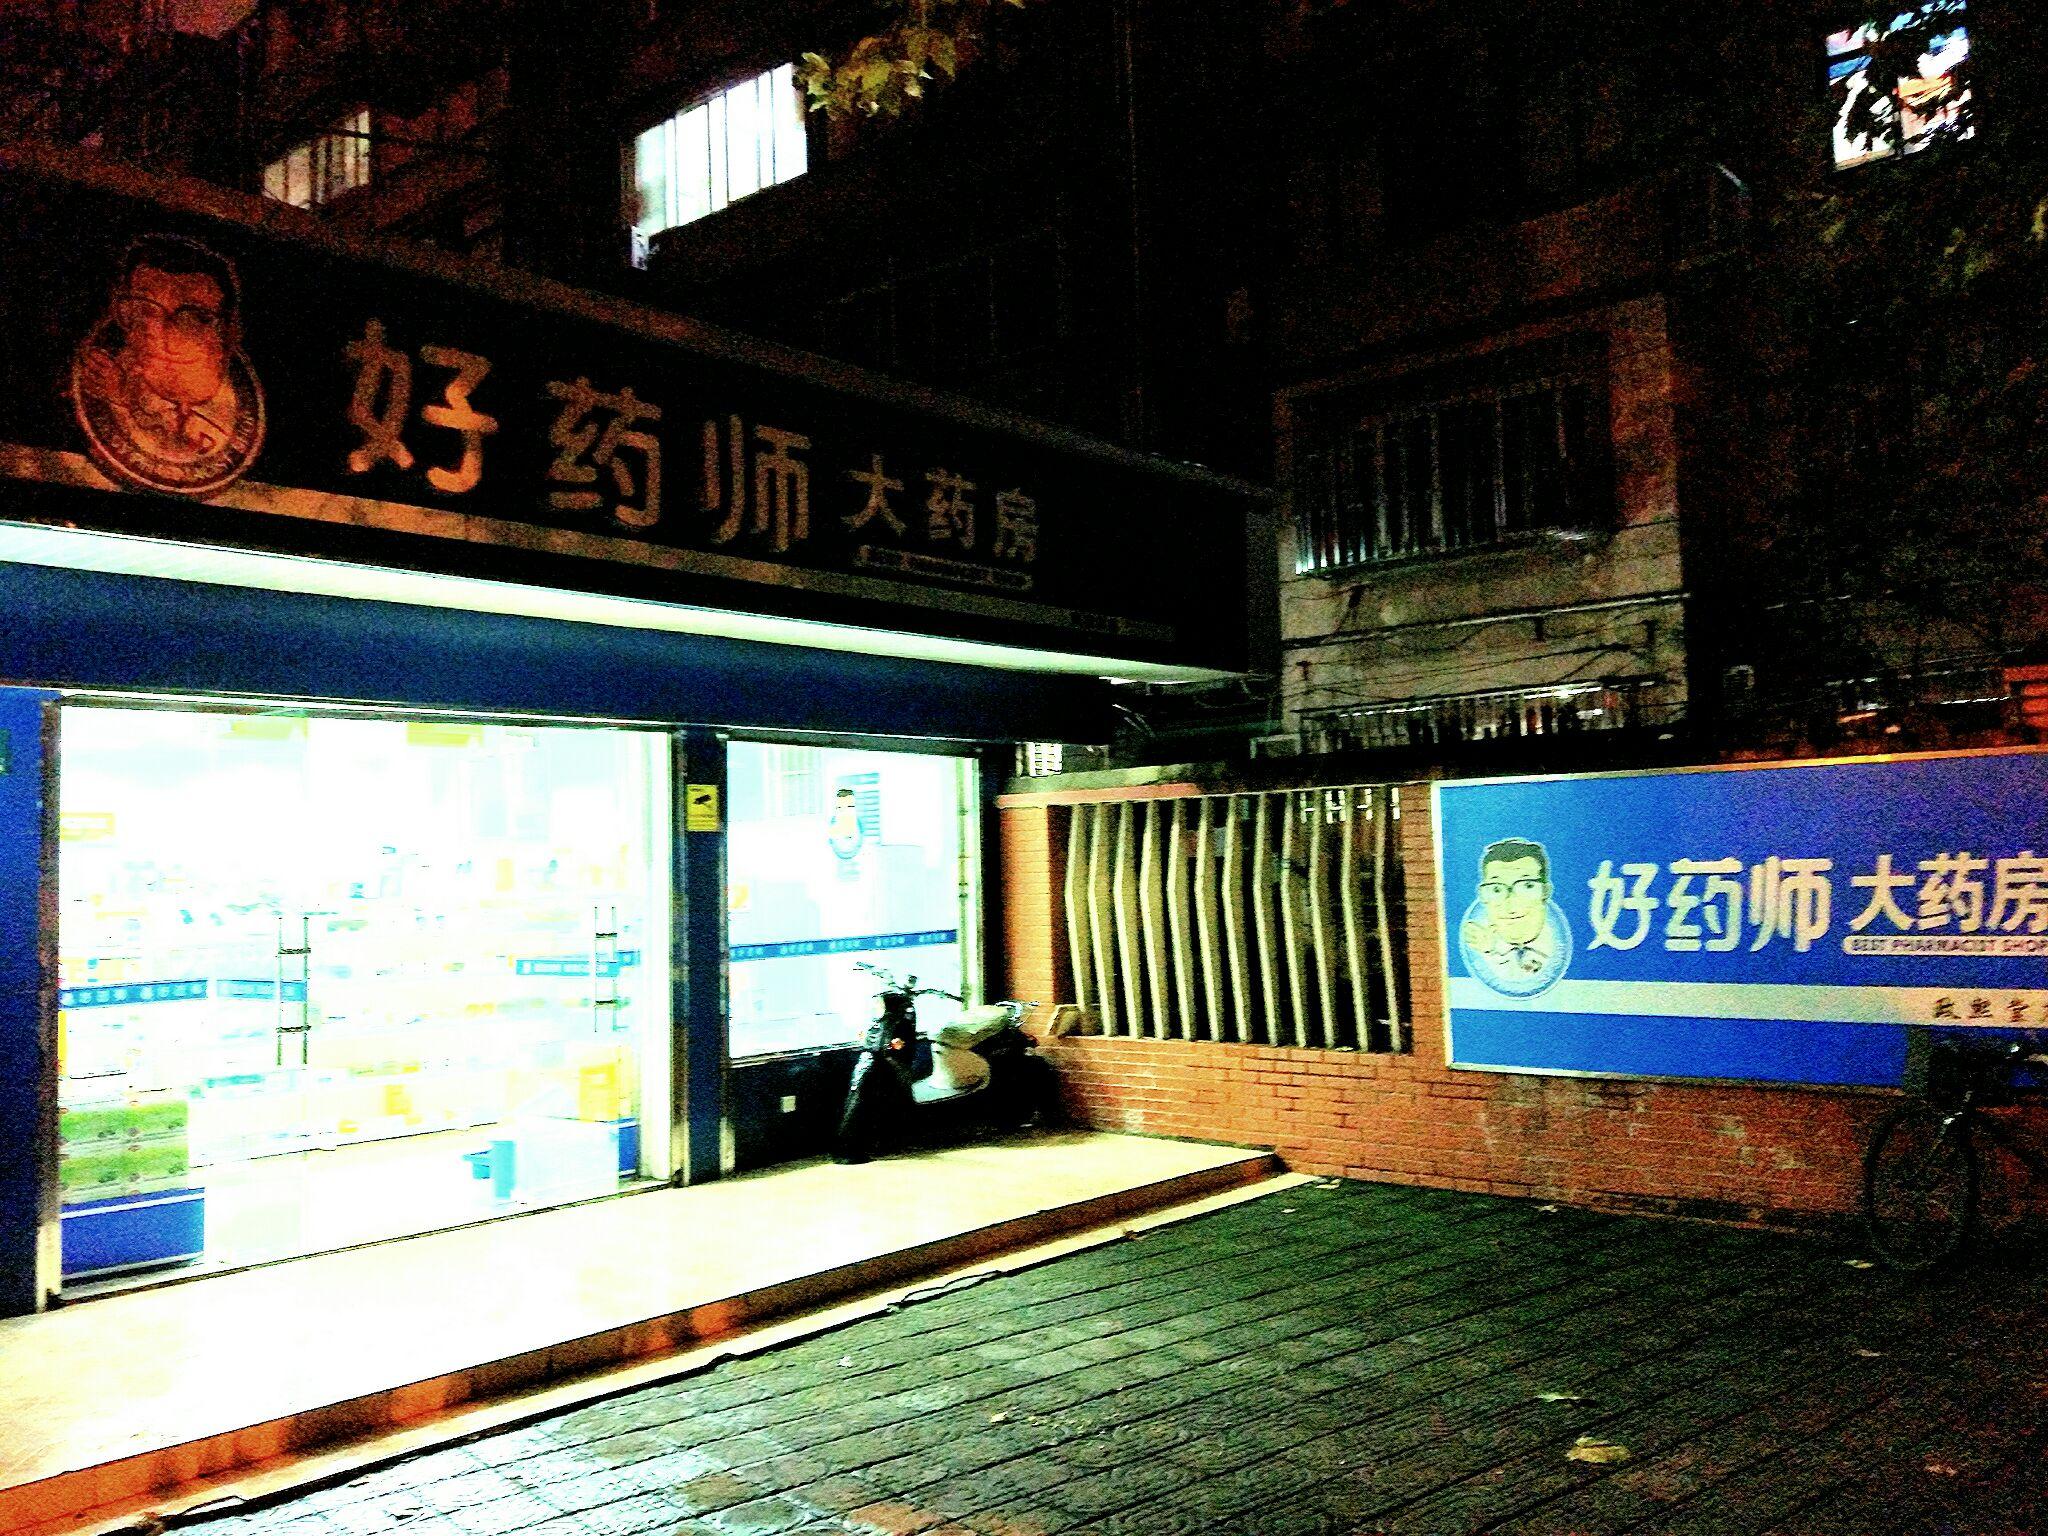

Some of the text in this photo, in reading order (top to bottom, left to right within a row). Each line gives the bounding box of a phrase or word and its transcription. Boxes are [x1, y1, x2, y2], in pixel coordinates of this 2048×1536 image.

[344, 316, 812, 553] 好药师
[841, 454, 1040, 562] 大药房
[1586, 851, 2048, 952] 好药师 大药房
